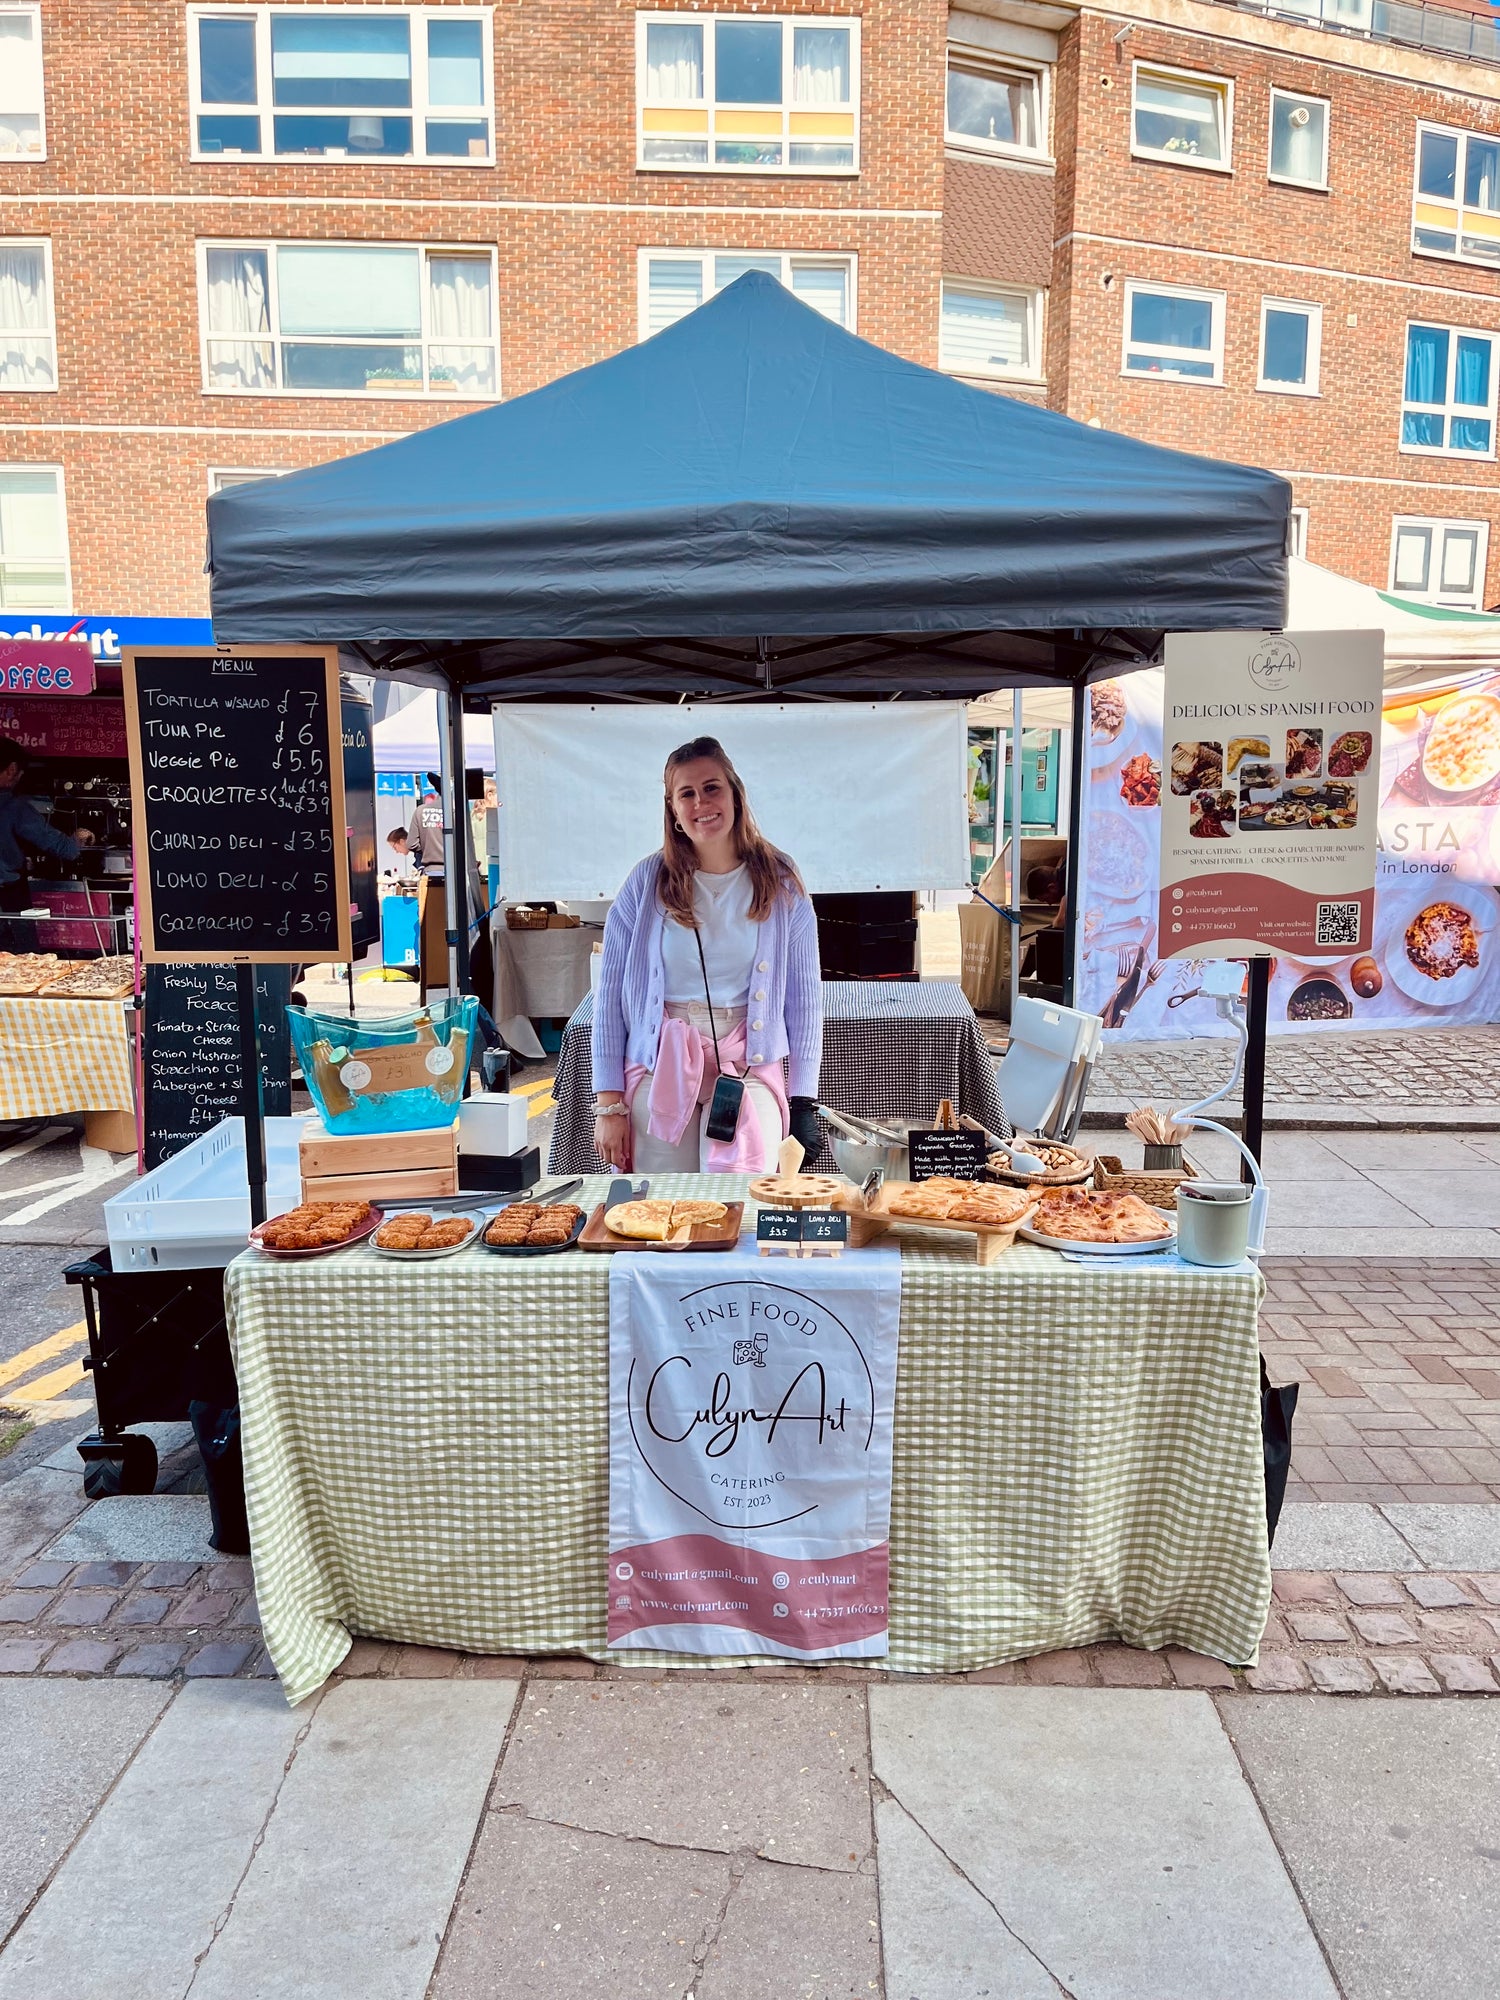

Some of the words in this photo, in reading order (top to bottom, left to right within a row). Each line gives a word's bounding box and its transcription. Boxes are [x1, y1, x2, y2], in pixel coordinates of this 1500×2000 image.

[212, 659, 254, 672] MENU
[144, 689, 218, 708] TORTILLA
[1173, 704, 1257, 718] DELICIOUS
[1260, 702, 1324, 716] SPANISH
[1328, 700, 1375, 714] FOOD
[145, 720, 191, 739] TUNA
[356, 730, 367, 748] Co.
[210, 751, 239, 769] Pie
[150, 830, 221, 851] CHORIZO
[229, 834, 263, 849] DELI
[1173, 848, 1205, 856] BESPOKE
[1286, 846, 1335, 854] CHARCUTERIE
[1335, 845, 1365, 853] BOARDS
[1221, 857, 1254, 865] TORTILLA
[1261, 856, 1309, 864] CROQUETTES
[1326, 855, 1347, 863] MORE
[1383, 860, 1396, 874] in
[1402, 860, 1458, 874] London
[156, 870, 208, 888] LOMO
[1185, 905, 1259, 915] culynart@gmail.com
[164, 975, 207, 995] Freshly
[187, 995, 239, 1012] Focacc
[152, 1020, 194, 1033] Tomato
[152, 1049, 187, 1059] Onion
[151, 1063, 220, 1076] Stracchino
[152, 1079, 216, 1095] Aubergine
[816, 1226, 831, 1236] £5
[684, 1301, 740, 1333] FINE
[750, 1301, 818, 1336] FOOD
[710, 1471, 786, 1490] CATERING
[723, 1496, 744, 1508] EST.
[747, 1494, 772, 1509] 2023
[641, 1568, 759, 1585] culynart@gmail.com
[799, 1573, 857, 1587] @culynart
[640, 1599, 749, 1614] www.culynart.com
[818, 1606, 844, 1619] 7537
[846, 1604, 885, 1616] 166623
